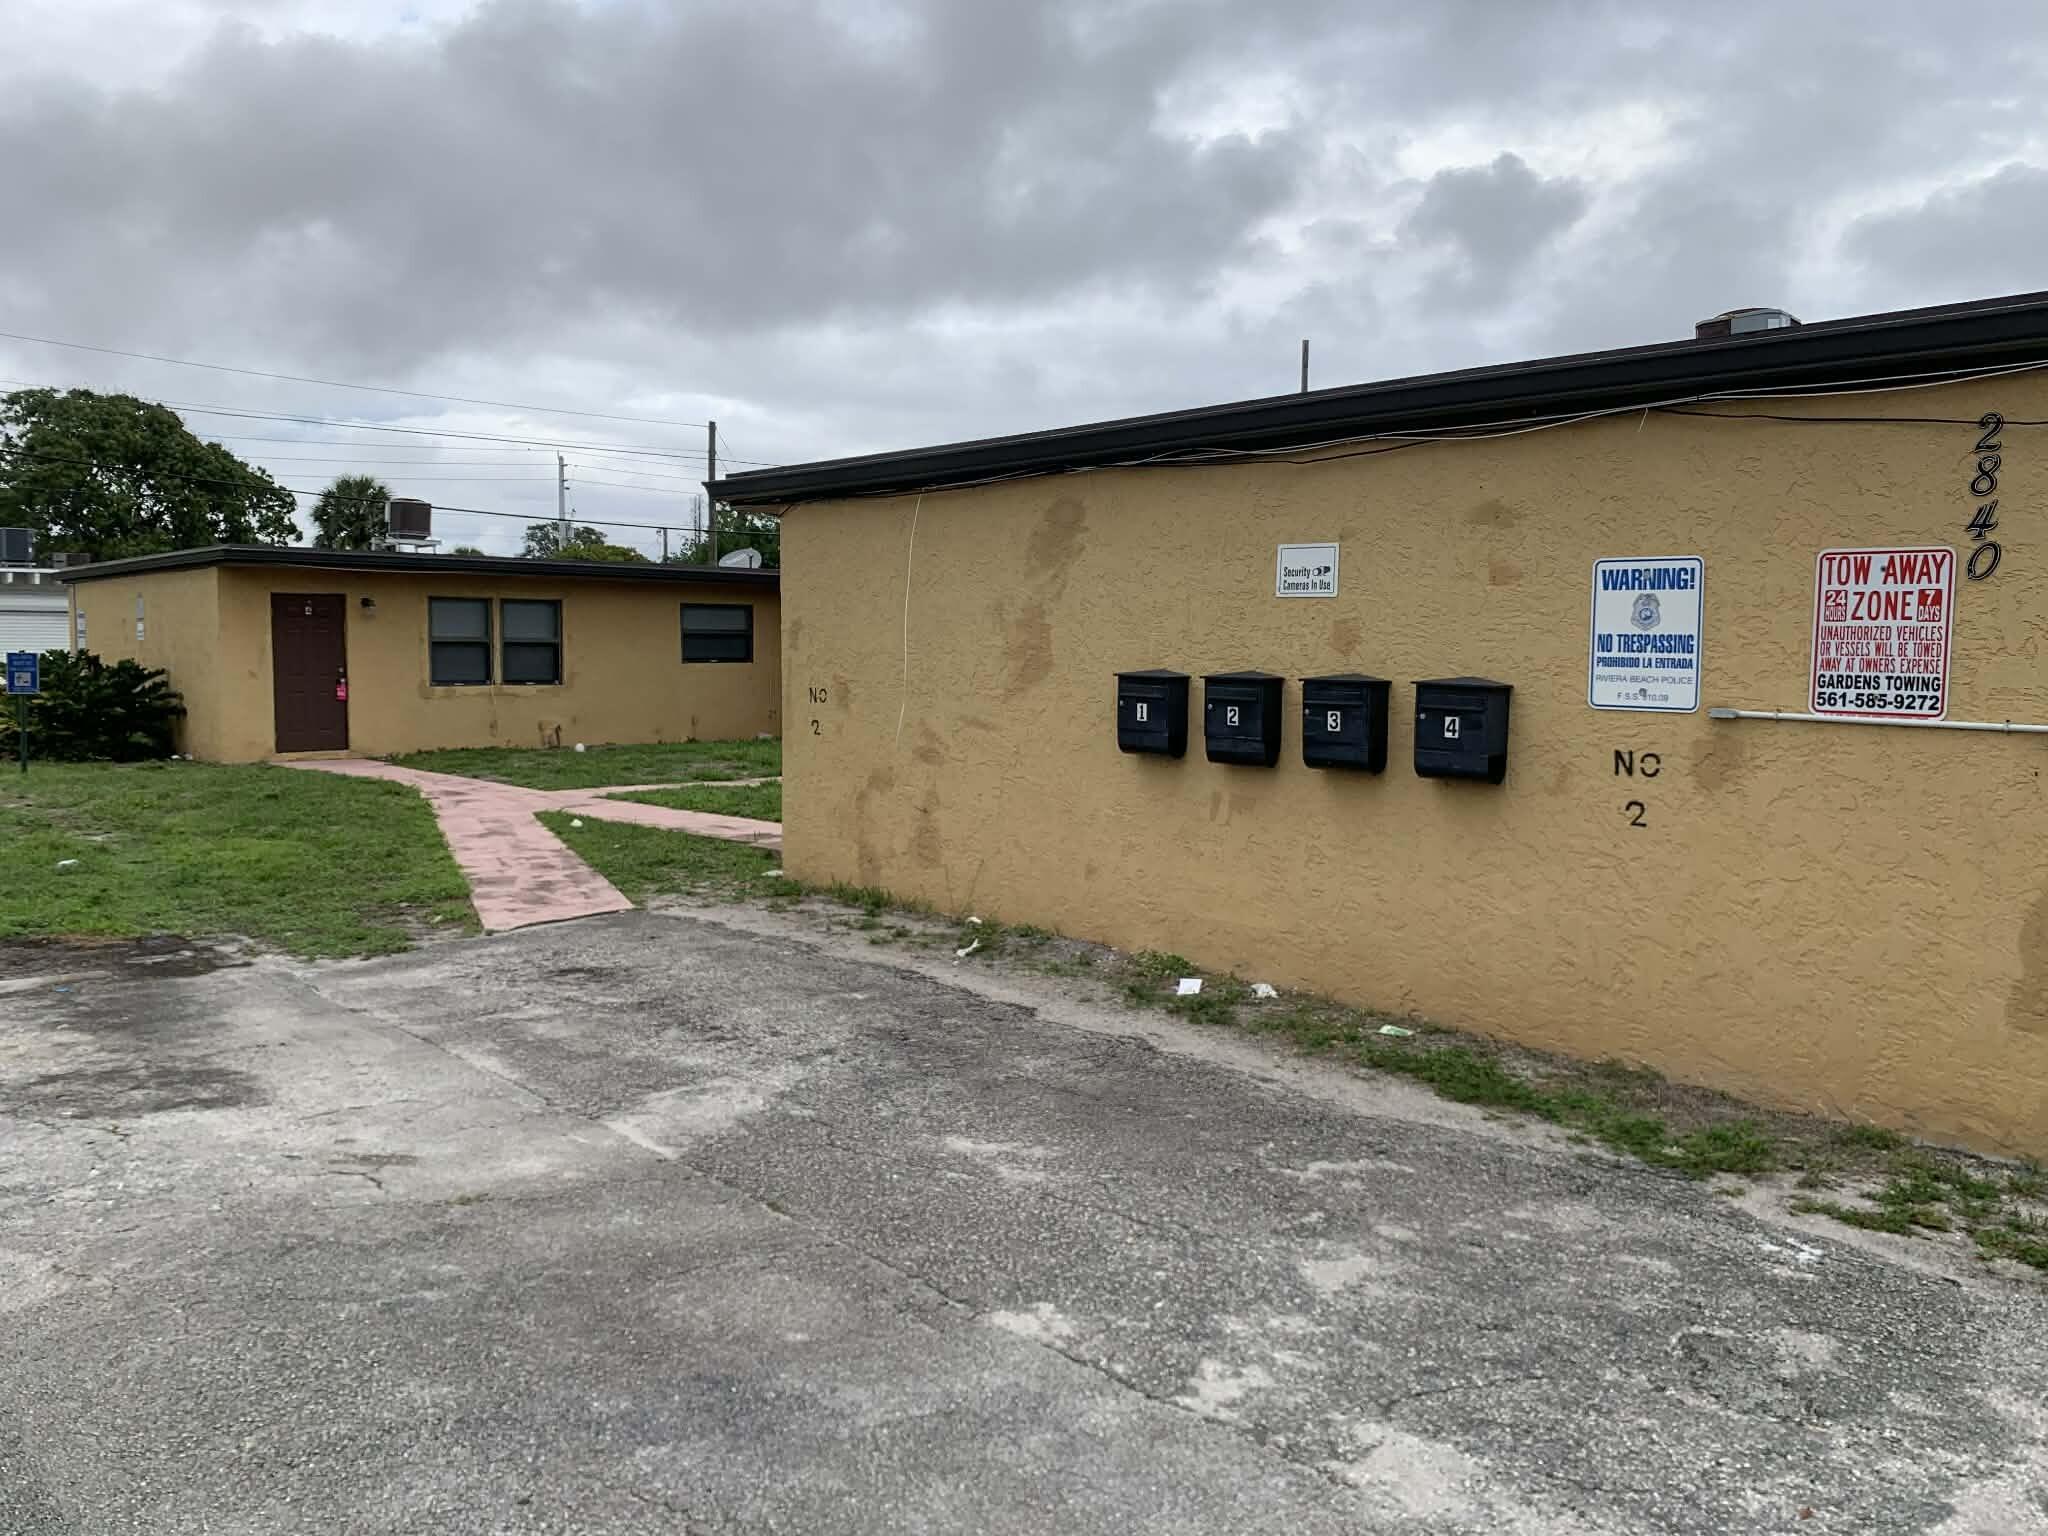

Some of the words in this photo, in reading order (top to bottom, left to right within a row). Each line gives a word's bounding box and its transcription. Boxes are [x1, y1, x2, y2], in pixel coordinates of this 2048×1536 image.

[1966, 412, 2004, 581] 2840
[1284, 566, 1310, 579] Security
[1825, 556, 1872, 585] TOW
[1883, 553, 1947, 584] AWAY
[1283, 580, 1310, 591] Cameras
[1311, 579, 1318, 590] In
[1320, 579, 1330, 590] Use
[1601, 567, 1696, 591] WARNING!
[1826, 590, 1847, 605] 24
[1851, 590, 1914, 621] ZONE
[1924, 589, 1936, 605] 7
[1825, 605, 1846, 621] HOURS
[1918, 605, 1940, 621] DAYS
[1821, 625, 1892, 641] UNAUTHORIZED
[1897, 625, 1943, 642] VEHICLES
[1597, 634, 1613, 653] NO
[1616, 634, 1694, 654] TRESPASSING
[1820, 641, 1832, 656] OR
[1835, 641, 1871, 657] VESSELS
[1875, 641, 1894, 657] WILL
[1898, 642, 1909, 657] BE
[1913, 642, 1942, 658] TOWED
[1596, 656, 1640, 668] PROHIBIDO
[1642, 657, 1651, 669] LA
[1655, 658, 1694, 669] ENTRADA
[1819, 657, 1842, 672] AWAY
[1845, 657, 1856, 673] AT
[1858, 657, 1896, 673] OWNERS
[1900, 659, 1941, 675] EXPENSE
[1595, 674, 1628, 683] RIVIERA
[1629, 674, 1660, 684] BEACH
[1661, 675, 1694, 685] POLICE
[1817, 674, 1881, 690] GARDENS
[1885, 675, 1941, 692] TOWING
[809, 687, 828, 704] NO
[1816, 692, 1940, 711] 561-585-9272
[1228, 708, 1237, 725] 2
[1329, 712, 1339, 730] 3
[811, 719, 821, 735] 2
[1445, 718, 1457, 737] 4
[1614, 750, 1661, 778] NO
[1625, 801, 1648, 828] 2
